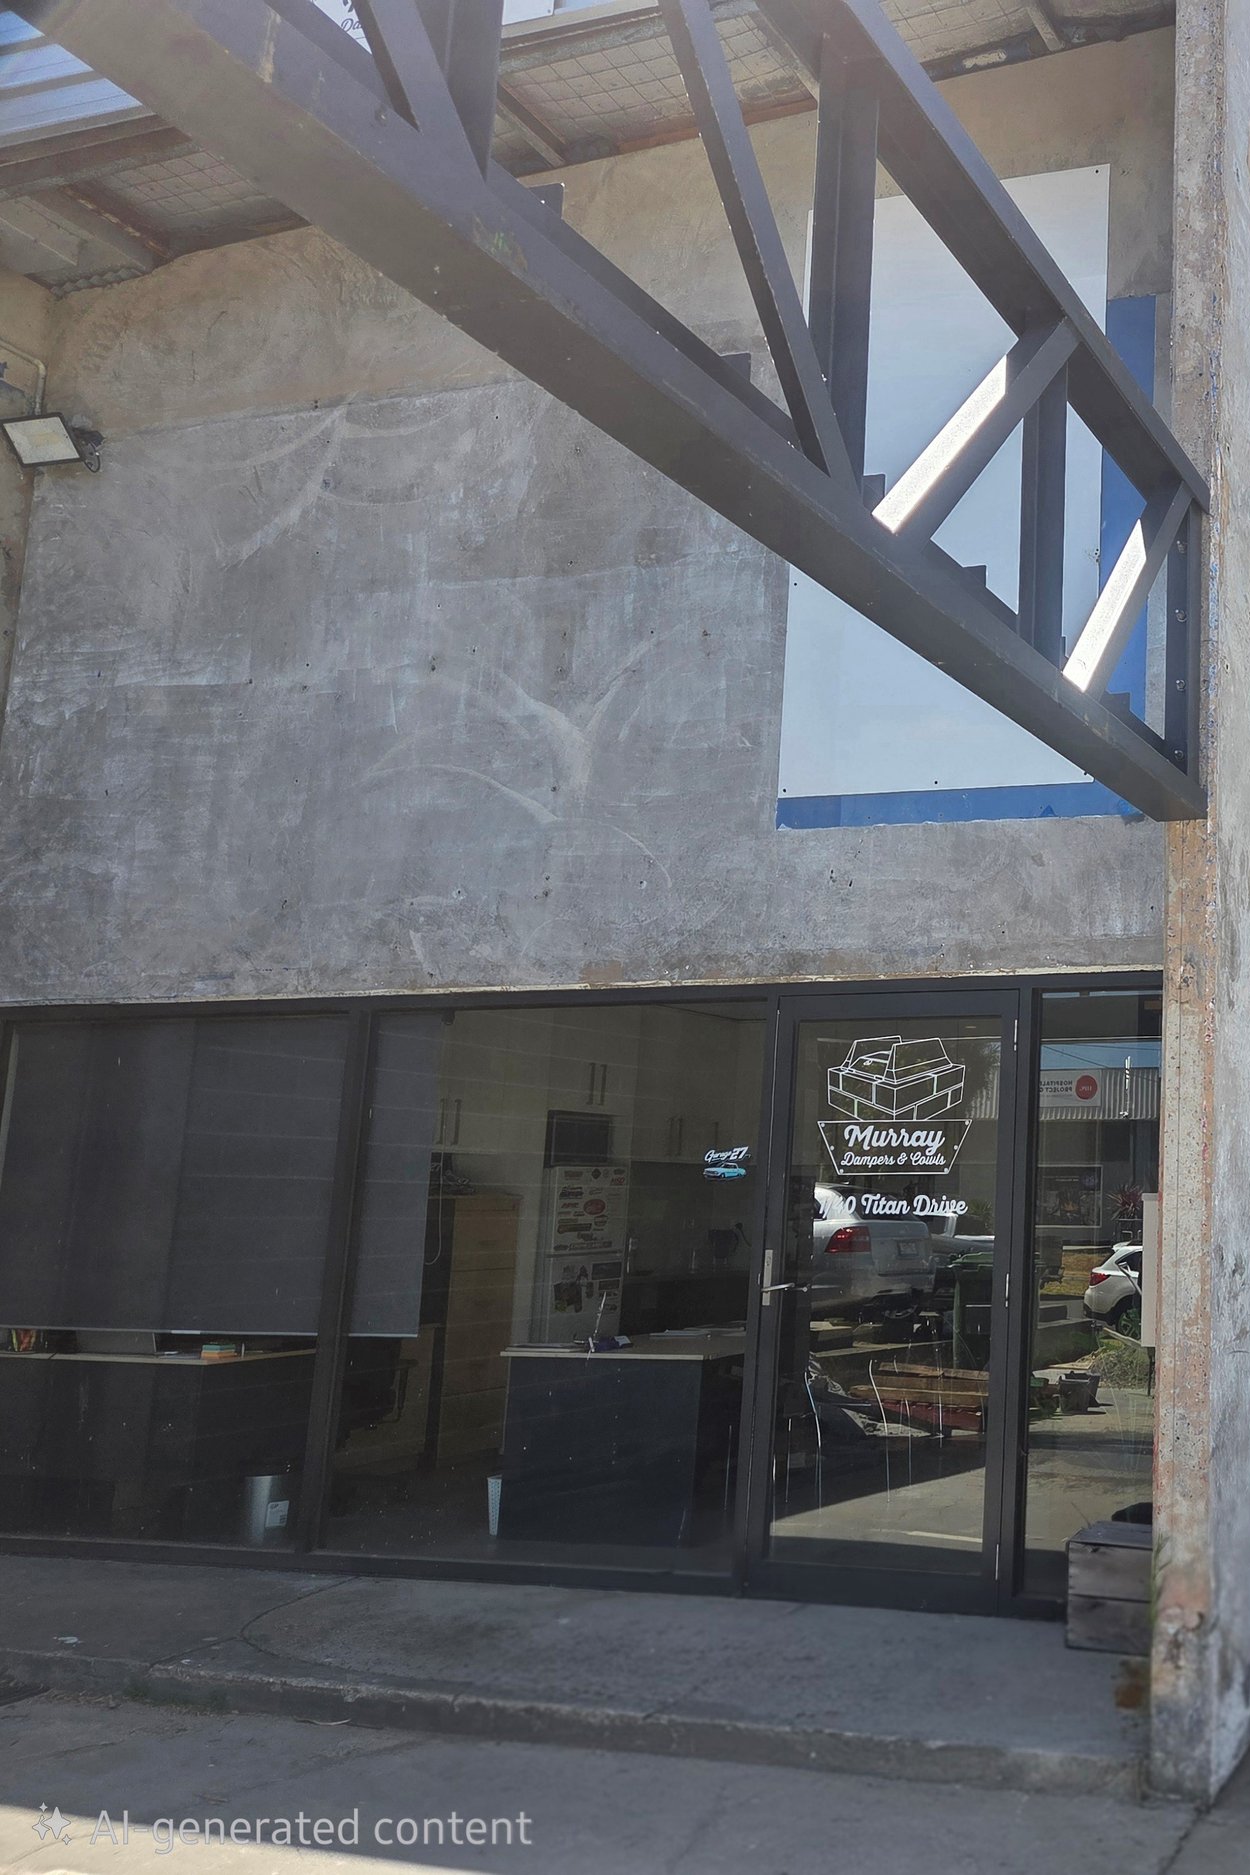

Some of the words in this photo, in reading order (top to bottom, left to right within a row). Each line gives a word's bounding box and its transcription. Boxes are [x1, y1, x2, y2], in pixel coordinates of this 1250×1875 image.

[844, 1124, 946, 1156] Murray
[730, 1146, 749, 1160] 27
[840, 1151, 896, 1169] Dampers
[896, 1151, 908, 1165] &
[909, 1151, 947, 1166] Cowls
[861, 1193, 911, 1215] Titan
[912, 1194, 968, 1216] Drive
